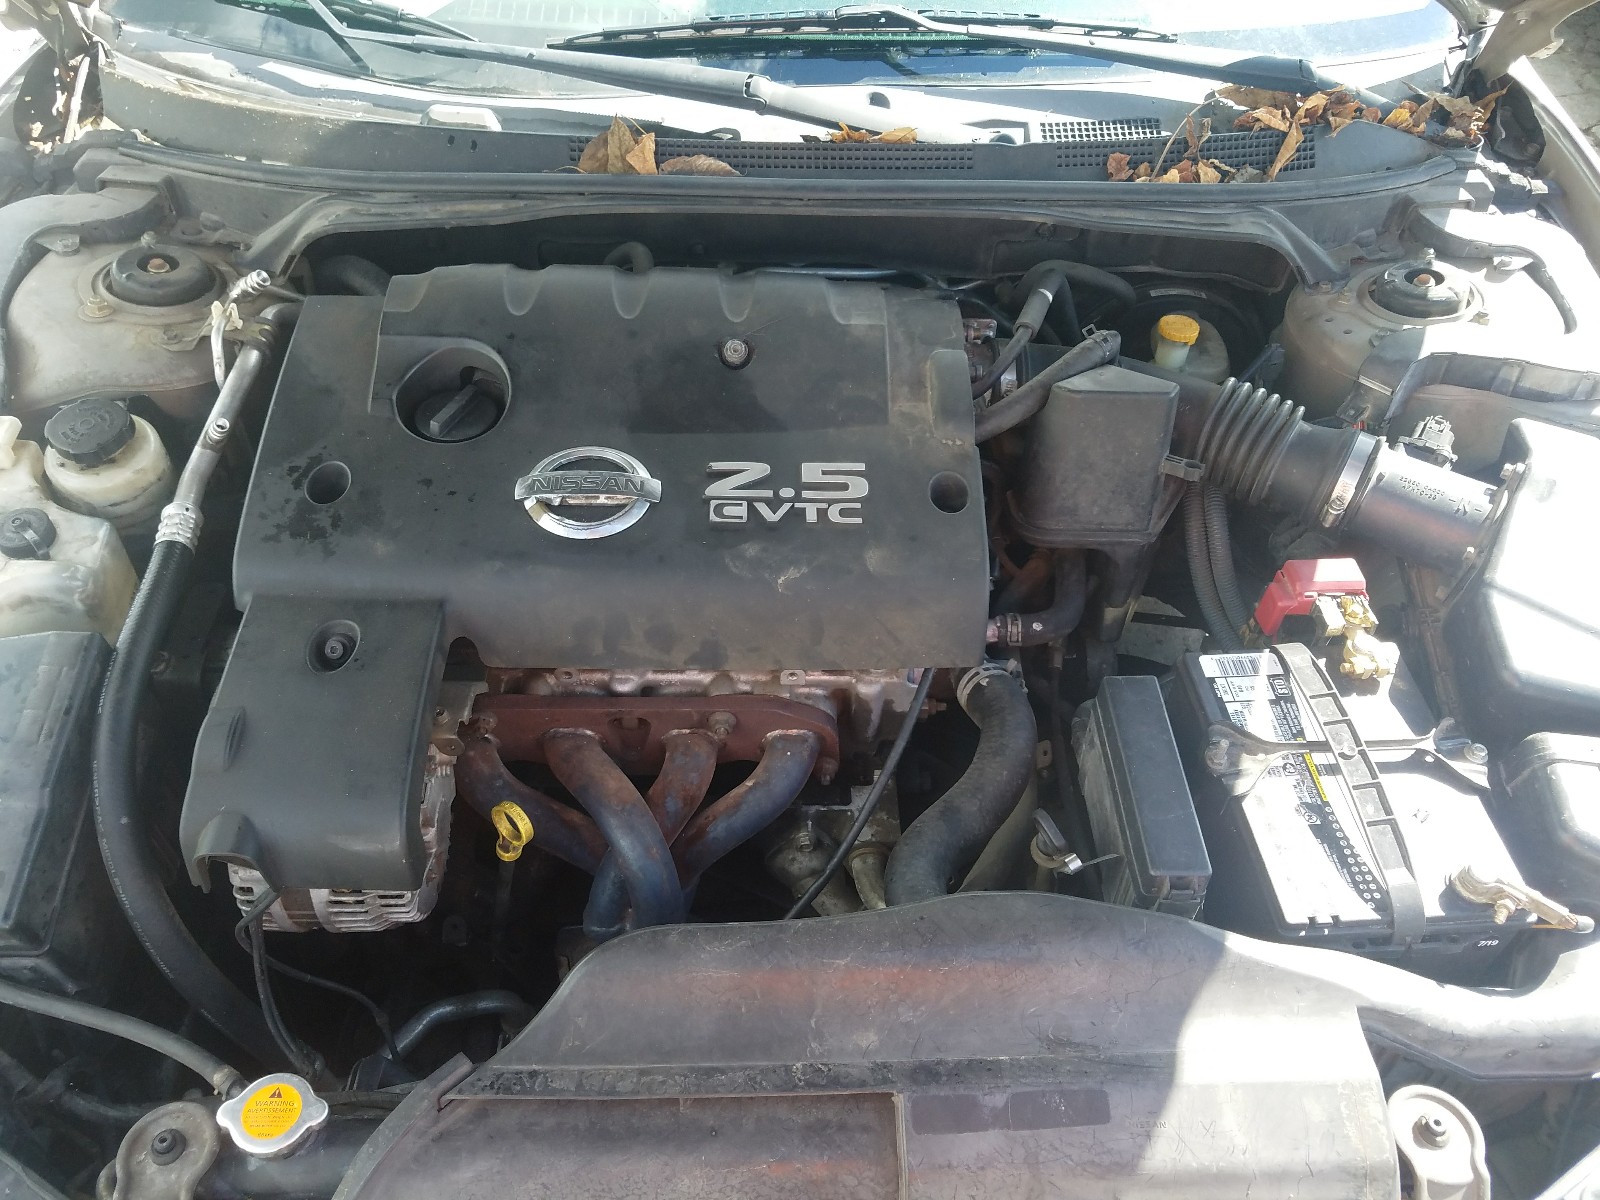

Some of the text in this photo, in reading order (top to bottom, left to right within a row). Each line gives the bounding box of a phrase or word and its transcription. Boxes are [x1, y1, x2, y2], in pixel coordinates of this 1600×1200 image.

[531, 475, 645, 494] NISSAN
[704, 461, 869, 499] 2.5
[709, 500, 863, 524] CVTC
[1477, 939, 1499, 947] 7/19
